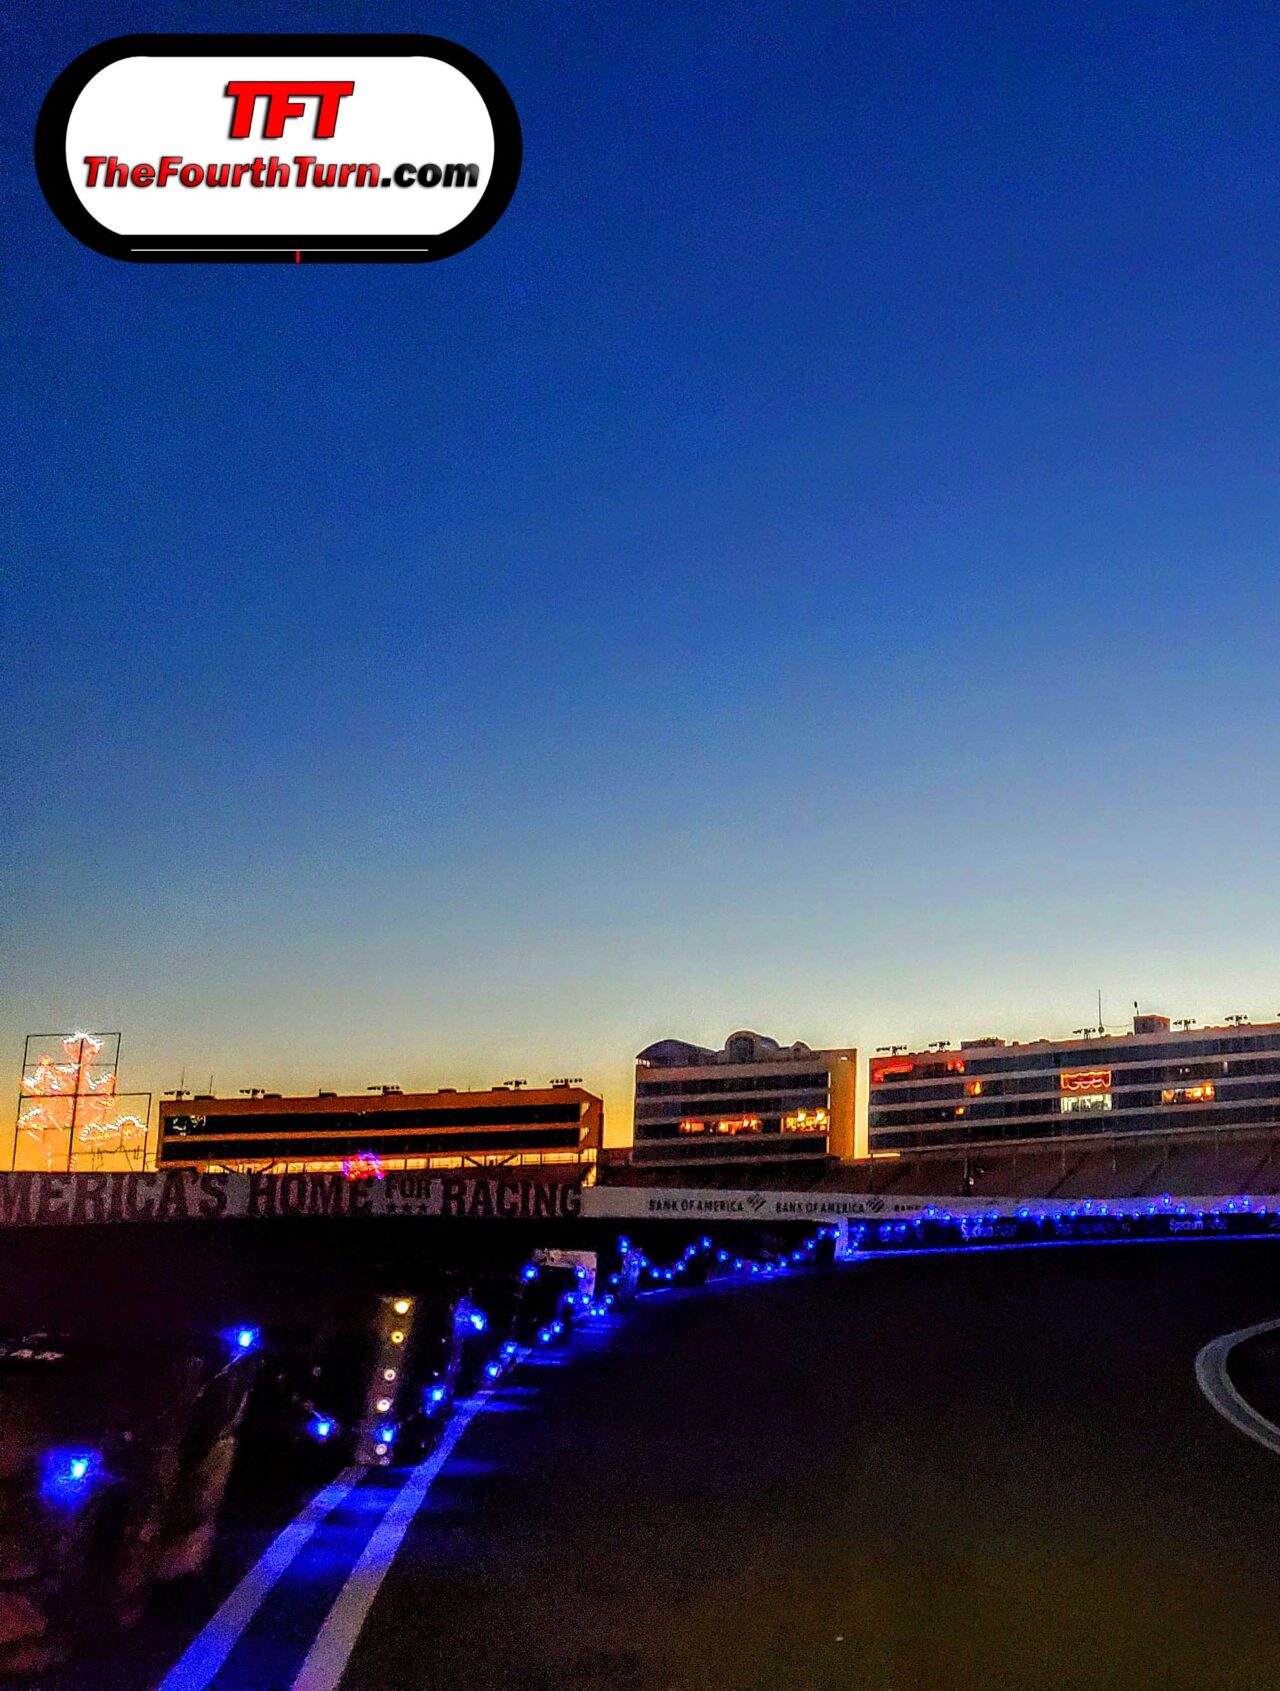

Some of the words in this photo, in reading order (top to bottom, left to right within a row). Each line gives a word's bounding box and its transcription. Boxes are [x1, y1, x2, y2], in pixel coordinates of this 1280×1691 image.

[442, 1180, 582, 1219] RACING
[649, 1199, 679, 1212] BANK
[681, 1199, 696, 1211] OF
[698, 1199, 744, 1212] AMERICA
[775, 1201, 803, 1213] BANK
[820, 1202, 865, 1214] AMERICA
